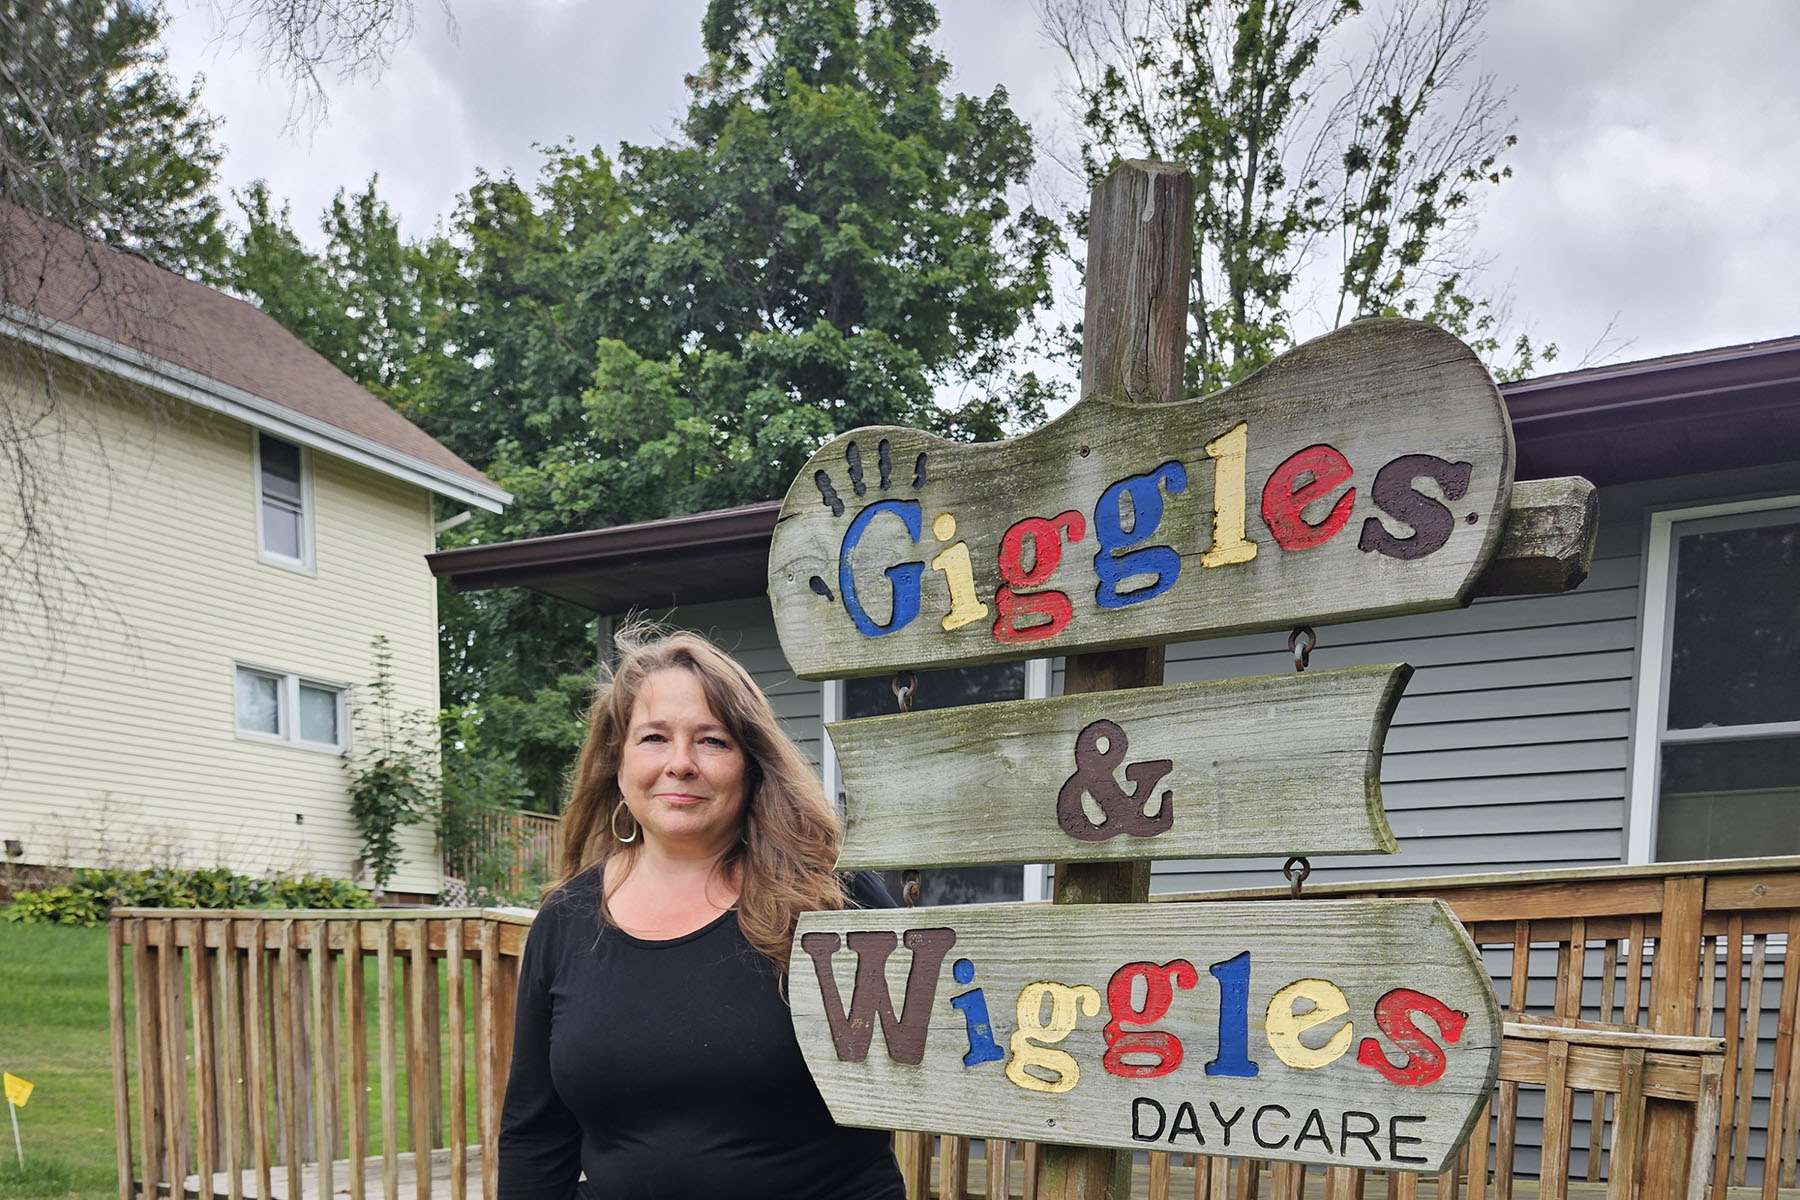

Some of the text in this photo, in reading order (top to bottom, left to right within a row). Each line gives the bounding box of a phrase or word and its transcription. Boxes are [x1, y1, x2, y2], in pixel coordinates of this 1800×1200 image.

[839, 421, 1473, 644] Giggles
[1057, 719, 1174, 842] &
[800, 927, 1470, 1093] Wiggles
[1131, 1097, 1430, 1165] DAYCARE
